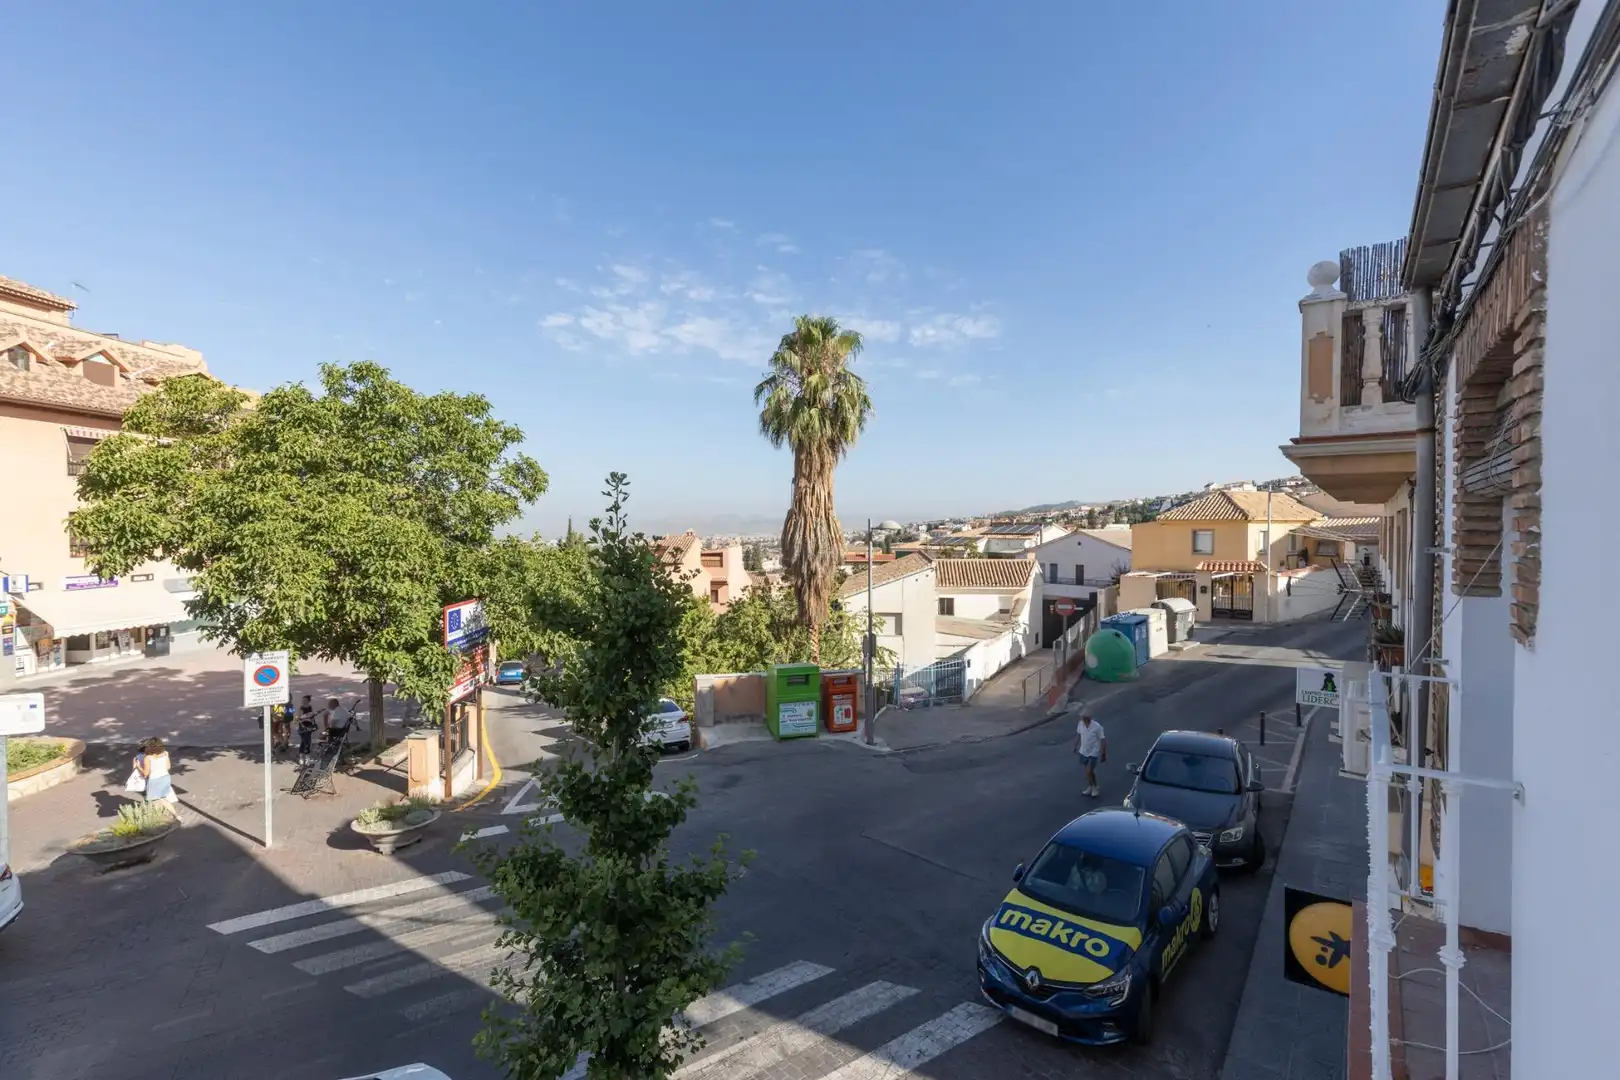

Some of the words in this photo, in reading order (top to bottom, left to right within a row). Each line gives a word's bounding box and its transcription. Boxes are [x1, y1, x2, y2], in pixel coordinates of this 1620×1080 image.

[1302, 694, 1339, 706] LIDERC
[1000, 908, 1110, 957] makro
[1162, 914, 1191, 973] makro
